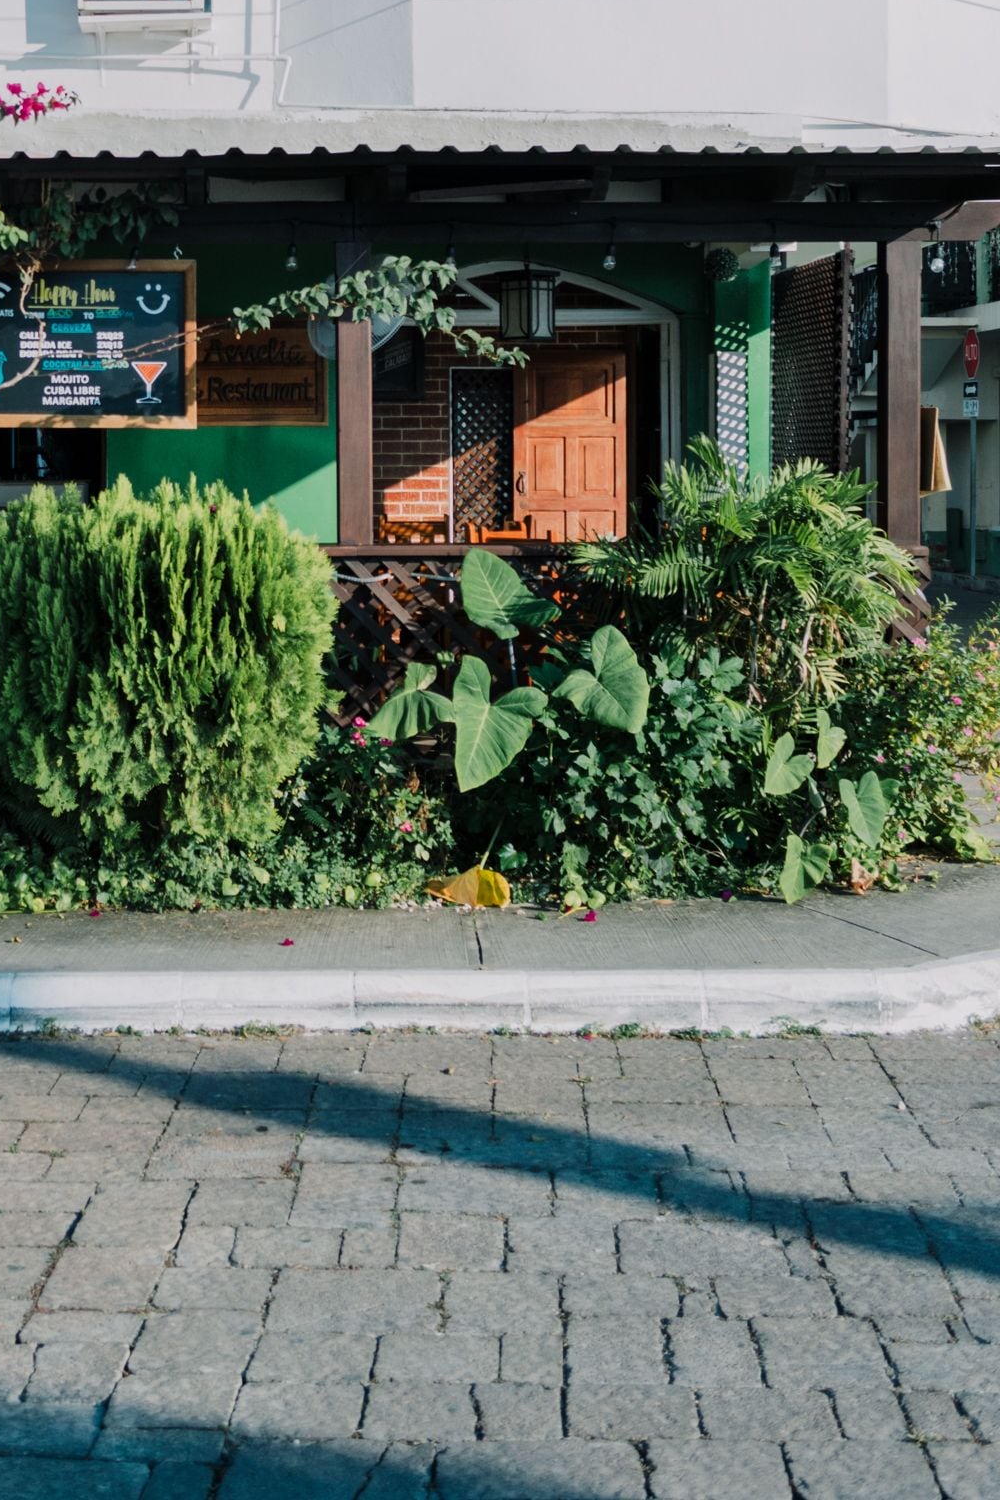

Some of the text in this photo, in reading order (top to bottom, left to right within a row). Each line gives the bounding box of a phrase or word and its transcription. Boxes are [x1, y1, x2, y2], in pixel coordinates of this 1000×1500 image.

[32, 278, 117, 307] Happy Hour
[83, 311, 95, 320] TO
[51, 323, 92, 333] CERVEZA
[57, 340, 73, 349] ICE
[50, 374, 90, 384] MOJITO
[43, 386, 101, 395] CUBA LIBRE
[207, 376, 316, 402] Restaurant
[42, 396, 101, 406] MARGARITA
